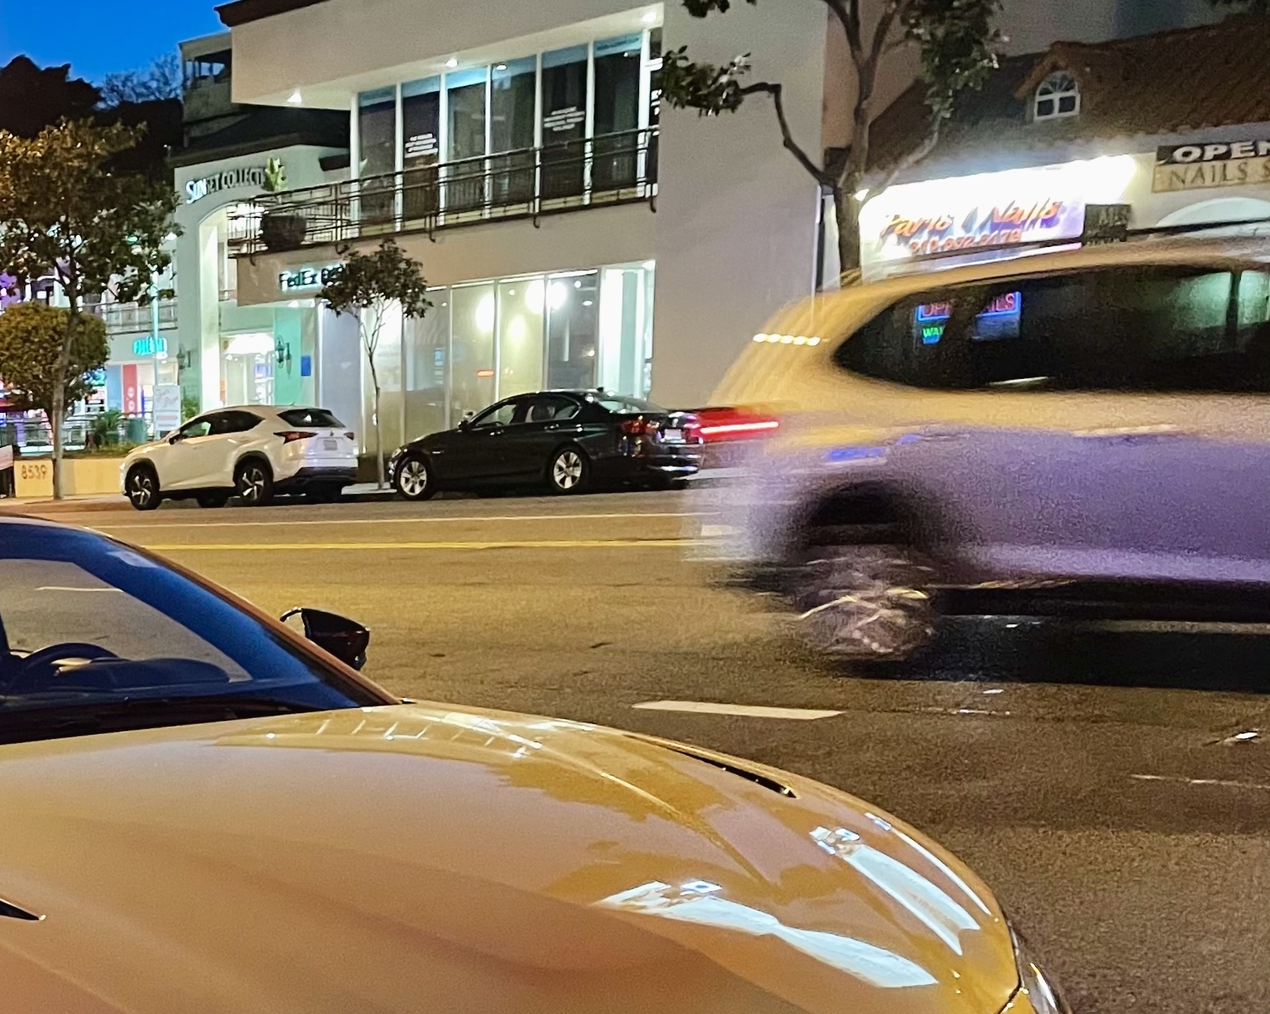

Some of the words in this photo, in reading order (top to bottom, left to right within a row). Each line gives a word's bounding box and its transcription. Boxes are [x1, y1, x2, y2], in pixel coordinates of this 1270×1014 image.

[1169, 162, 1248, 189] NAILS
[992, 198, 1063, 224] Nails
[278, 269, 318, 291] FedEx
[21, 464, 48, 480] 8539
